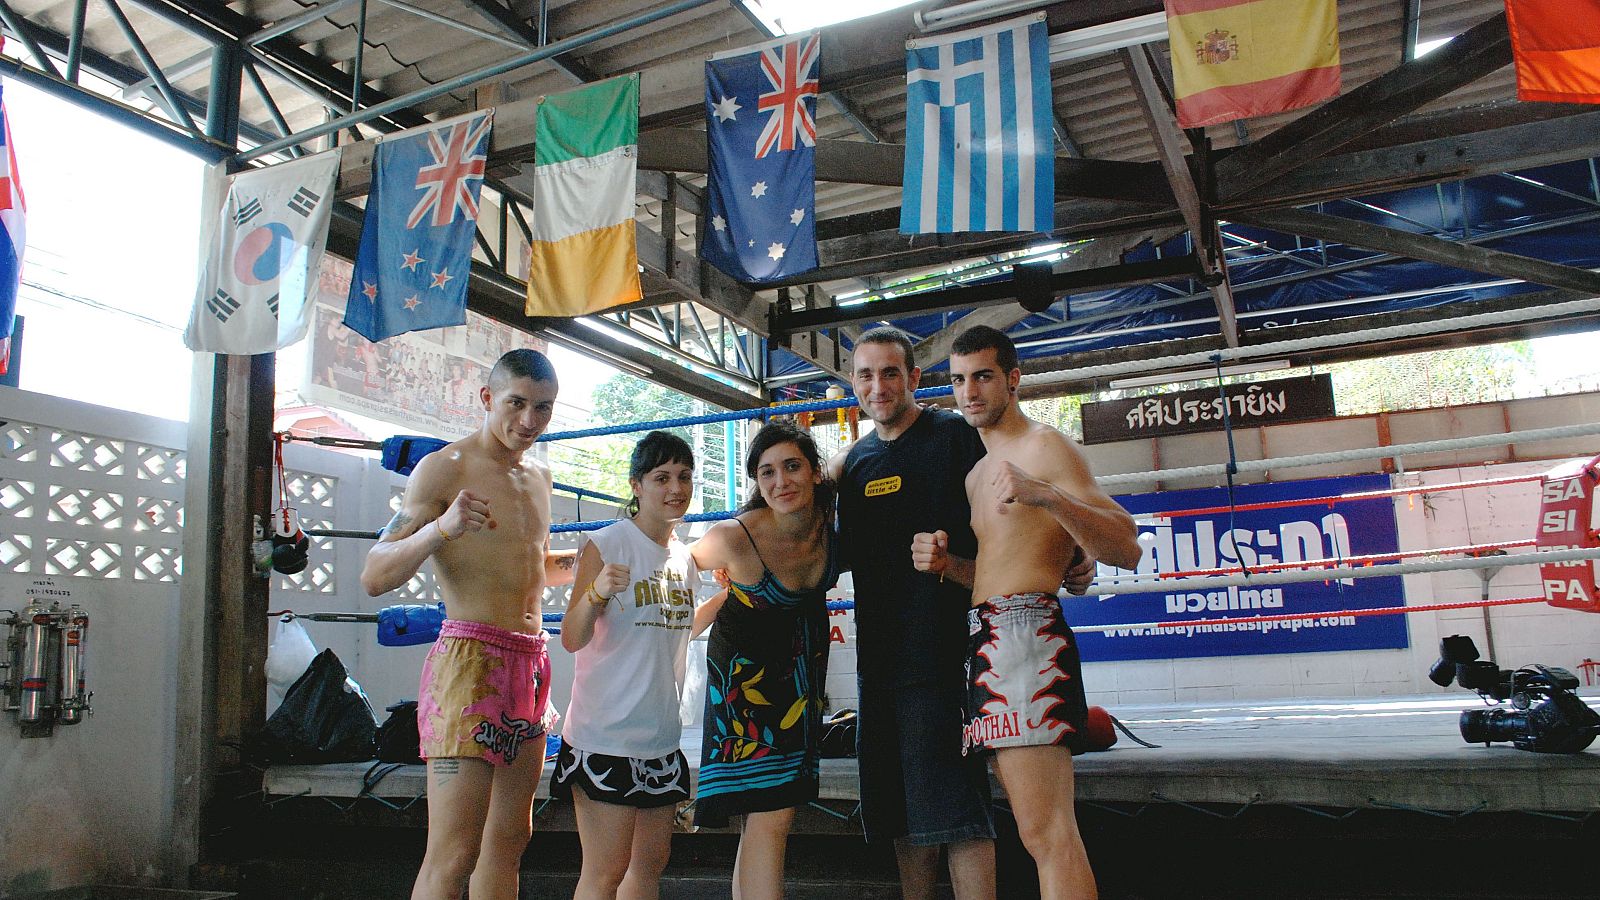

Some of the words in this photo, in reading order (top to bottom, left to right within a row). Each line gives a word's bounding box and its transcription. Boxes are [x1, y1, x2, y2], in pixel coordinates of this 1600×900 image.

[1126, 385, 1286, 429] ศศิประภายิม
[1543, 479, 1585, 503] SA
[1543, 509, 1577, 533] SI
[1544, 579, 1589, 601] PA
